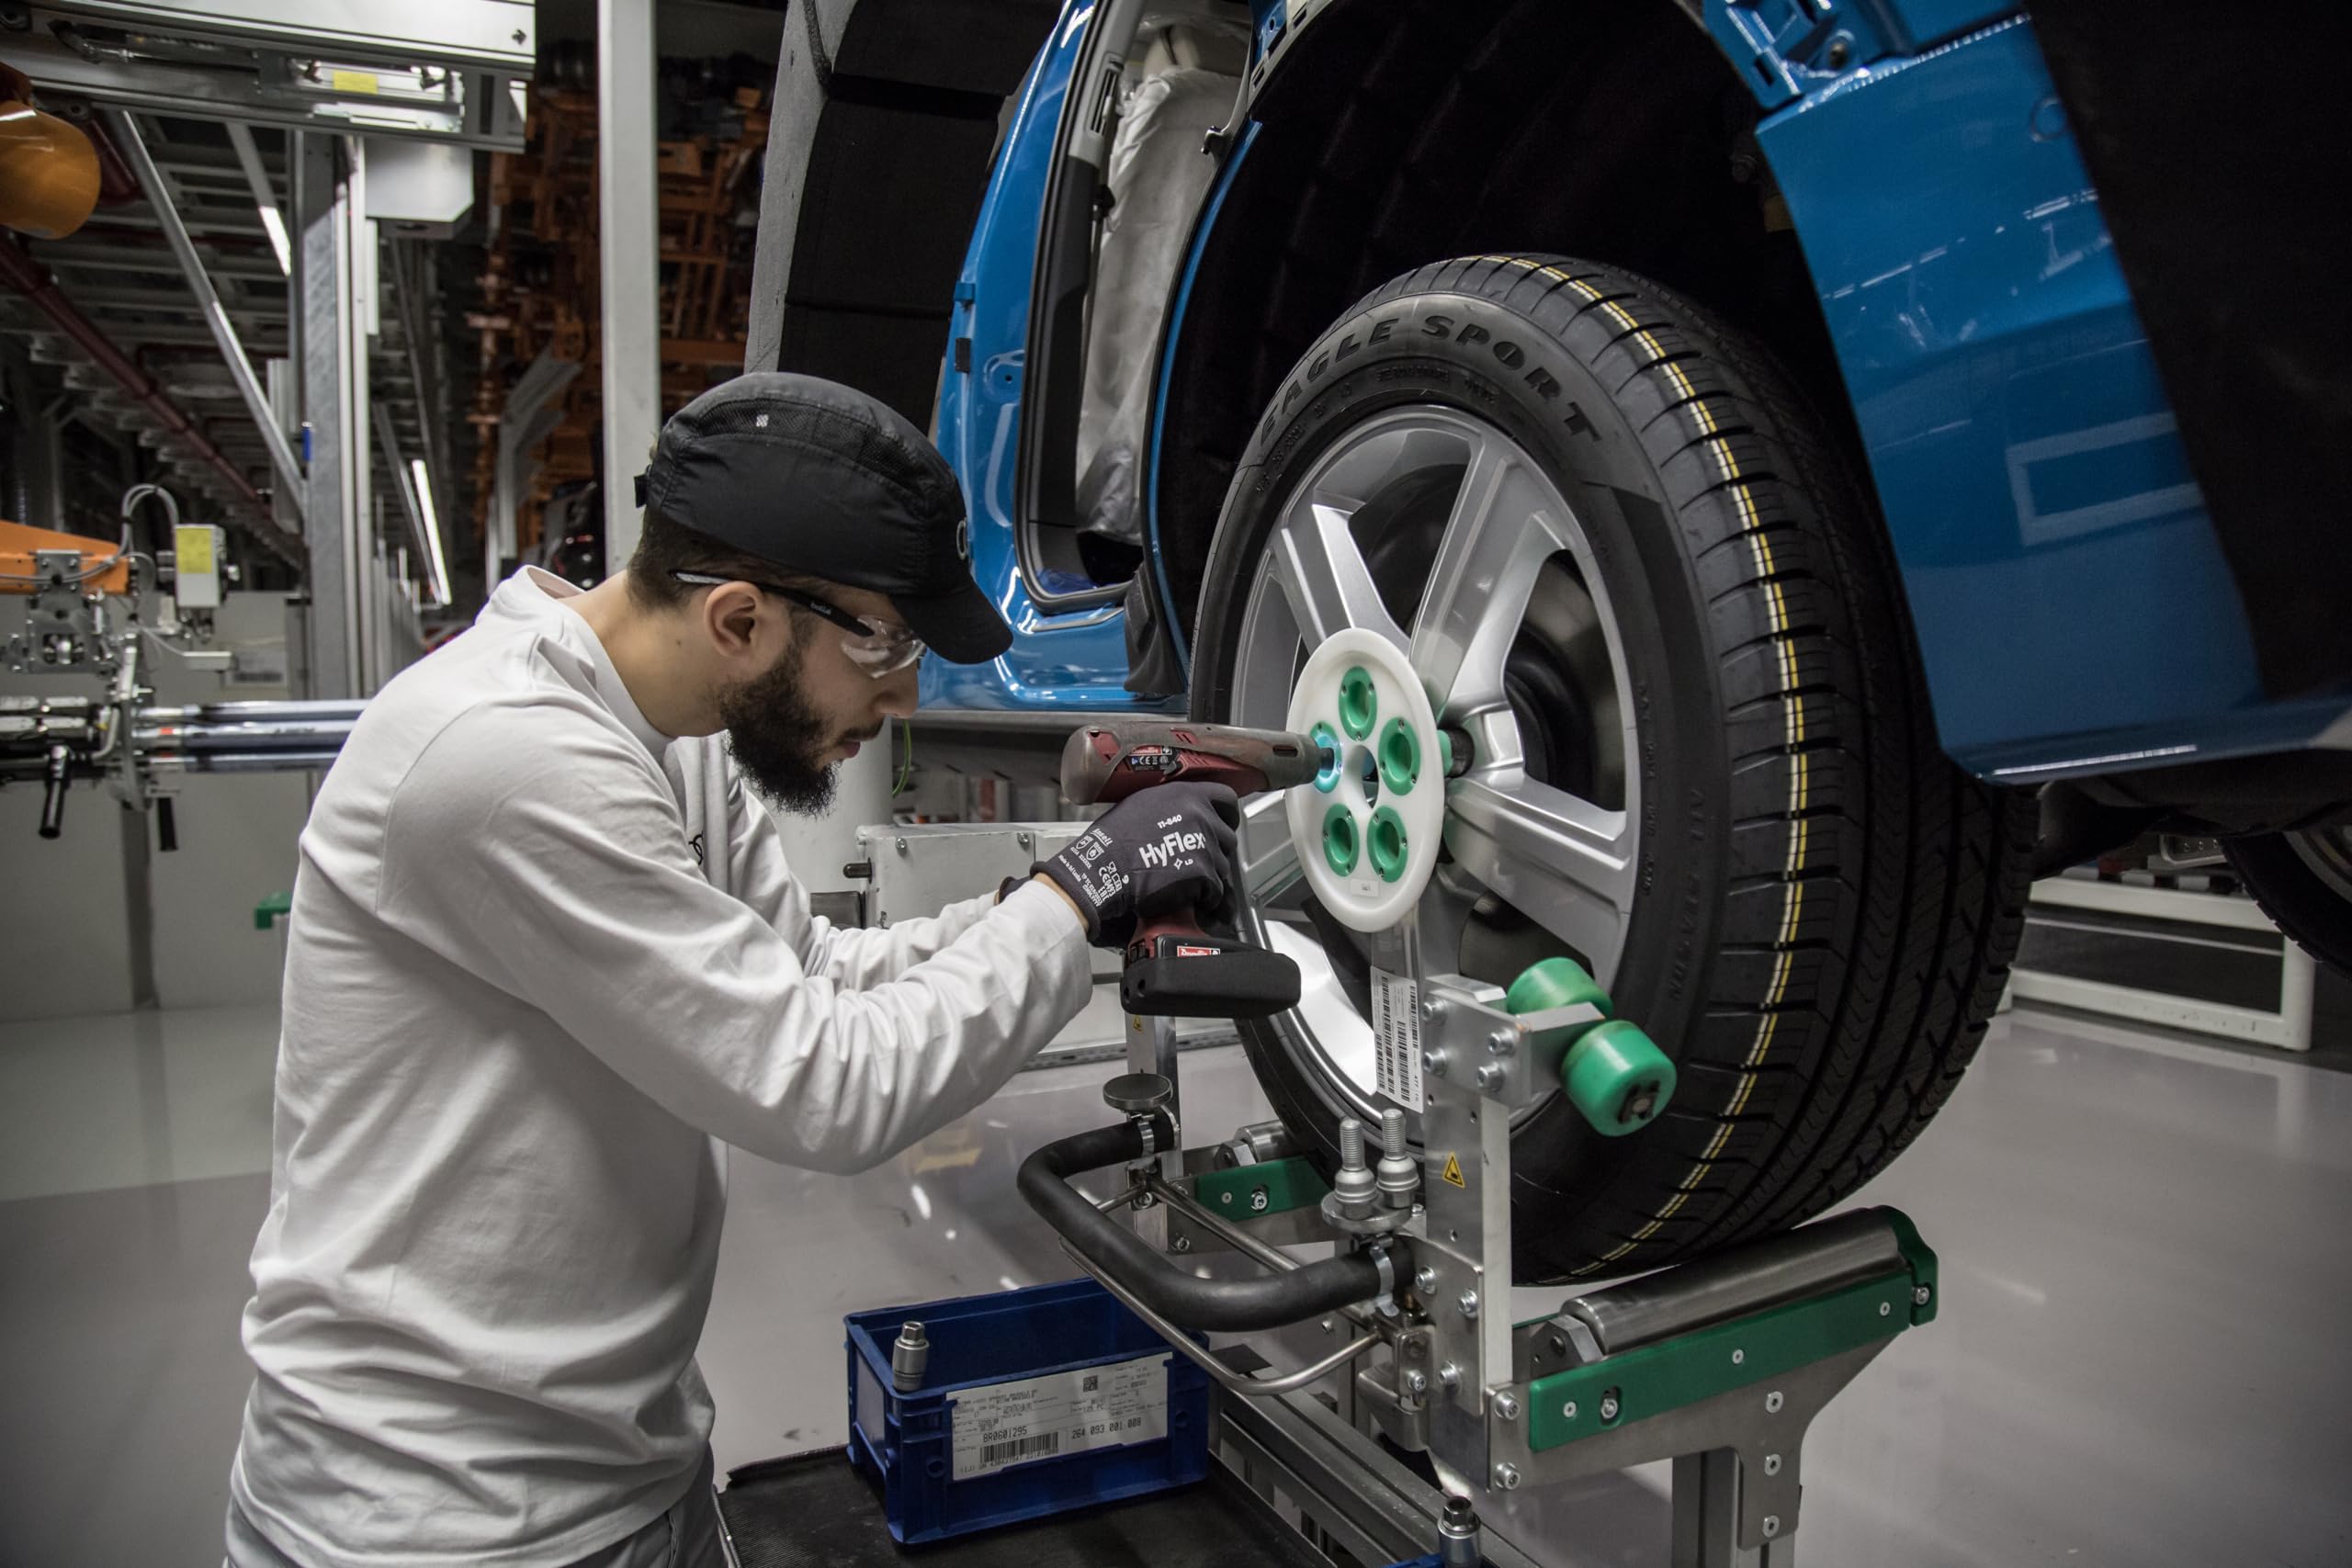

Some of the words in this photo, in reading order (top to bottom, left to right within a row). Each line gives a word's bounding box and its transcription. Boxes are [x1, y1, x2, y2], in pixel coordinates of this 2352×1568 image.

[1261, 318, 1400, 446] EAGLE
[1421, 315, 1602, 442] SPORT
[1091, 828, 1114, 846] Ansell
[1139, 831, 1205, 868] HyFlex
